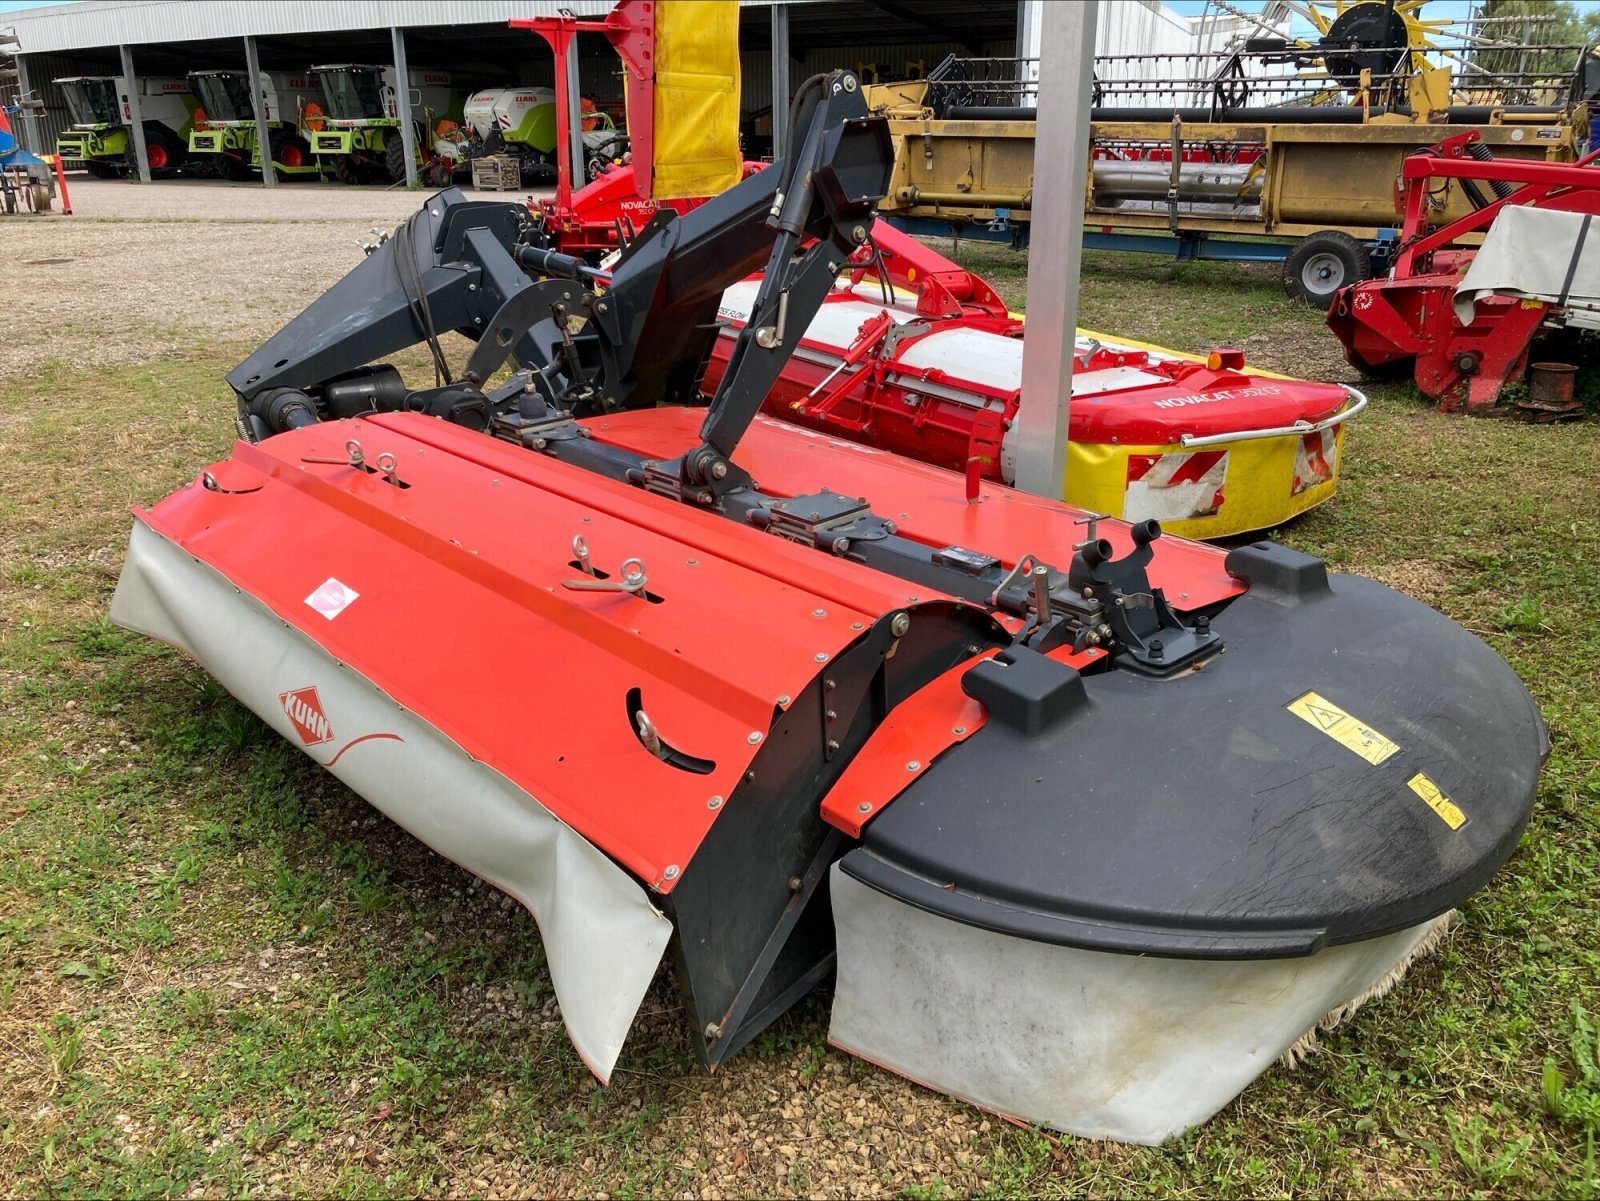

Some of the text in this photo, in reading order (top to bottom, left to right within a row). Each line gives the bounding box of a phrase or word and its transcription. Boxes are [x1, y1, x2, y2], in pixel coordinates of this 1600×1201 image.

[424, 75, 449, 83] CLAAS
[621, 200, 660, 210] NOVACAT
[728, 310, 748, 319] FLOW
[1153, 391, 1235, 409] NOVACAT
[284, 691, 329, 743] KUHN
